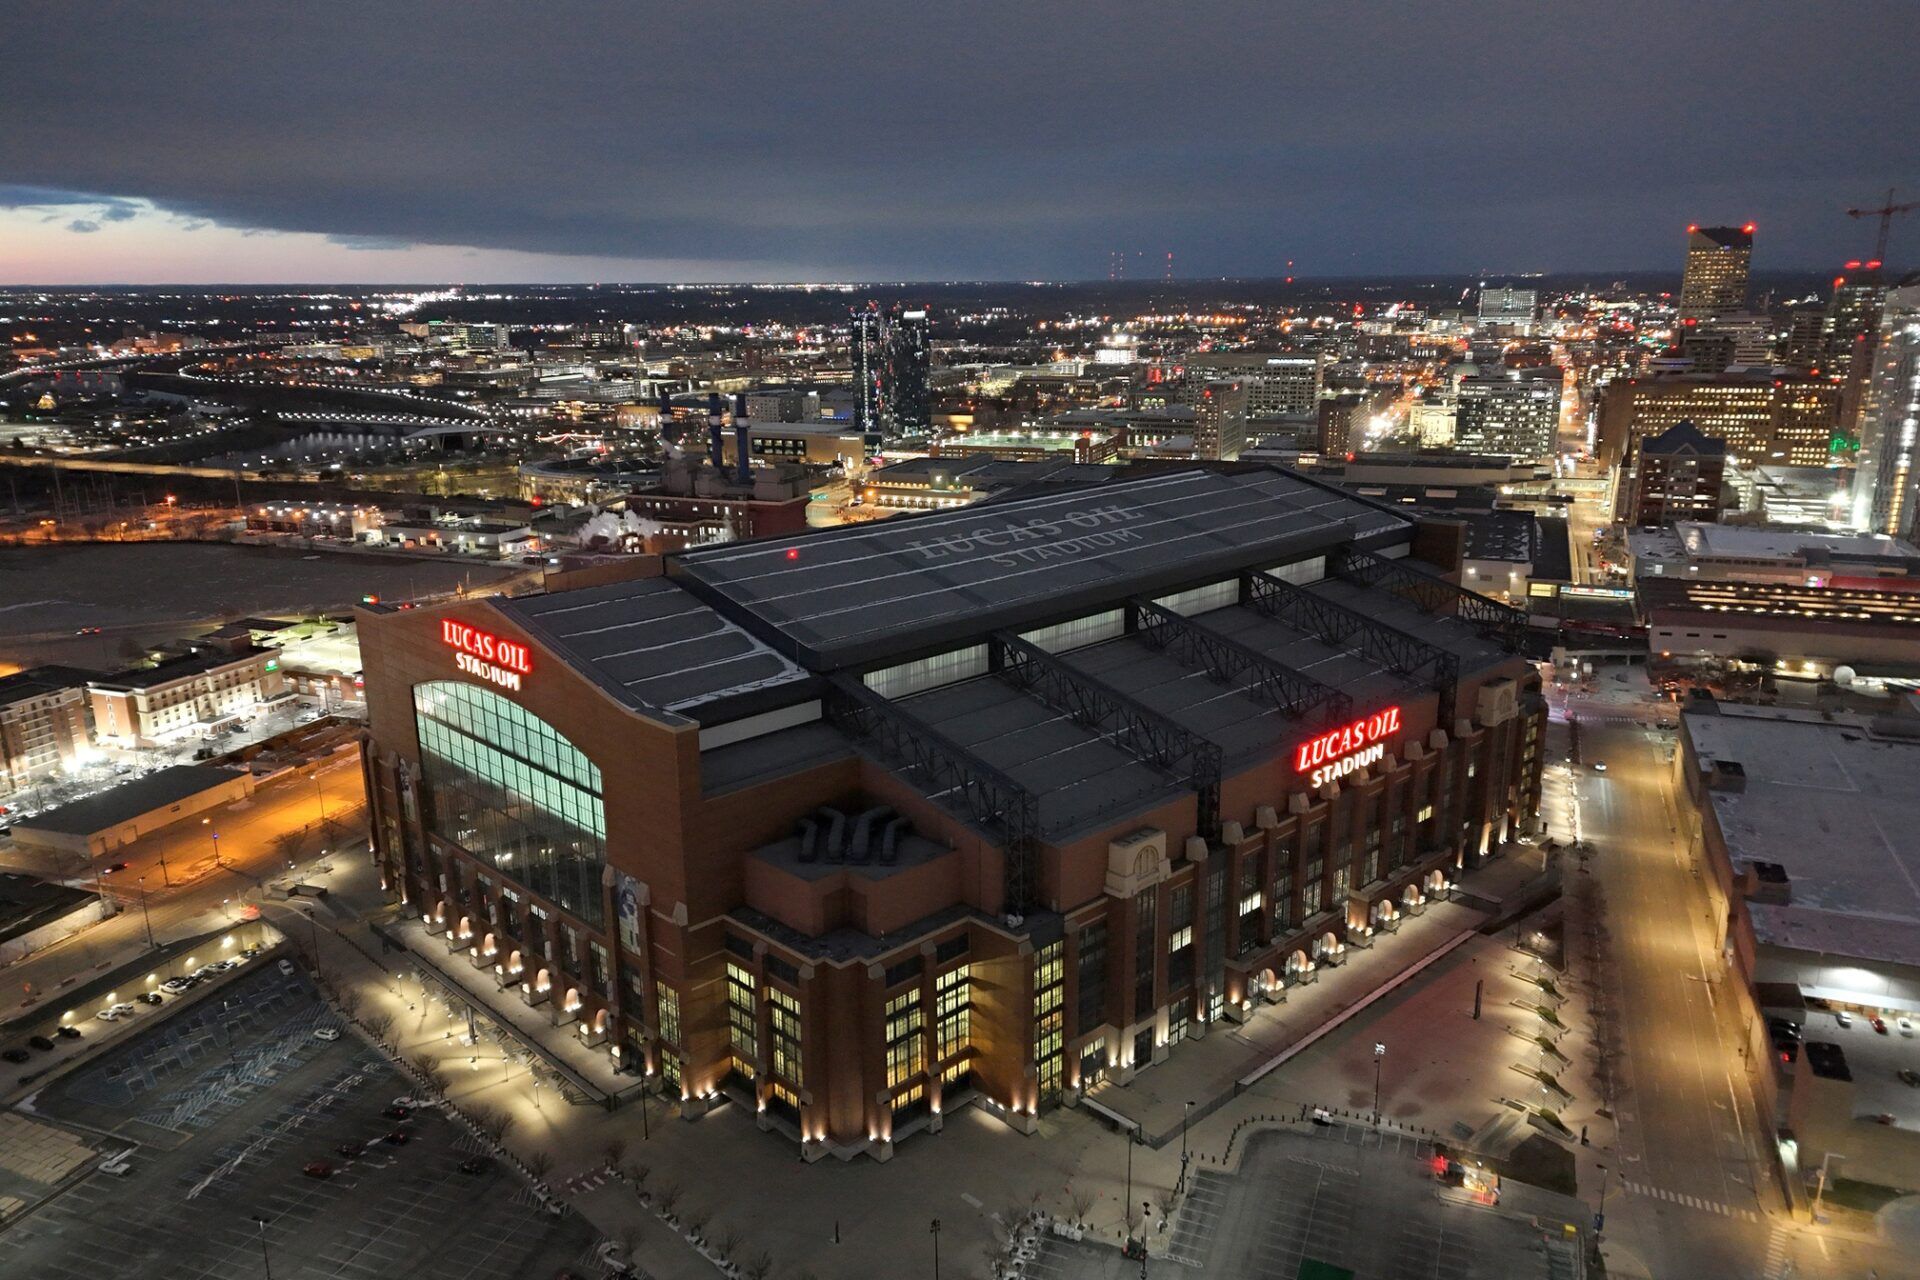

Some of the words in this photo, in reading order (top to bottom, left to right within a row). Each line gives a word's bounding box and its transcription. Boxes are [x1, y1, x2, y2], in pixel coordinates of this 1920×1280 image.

[906, 518, 1063, 560] LUCAS
[1065, 504, 1145, 528] OIL
[990, 528, 1143, 567] STADIUM
[442, 620, 494, 659] LUCAS
[497, 641, 529, 672] OIL
[455, 652, 520, 692] STADIUM
[1298, 721, 1365, 771] LUCAS
[1368, 708, 1400, 740] OIL
[1311, 743, 1384, 789] STADIUM
